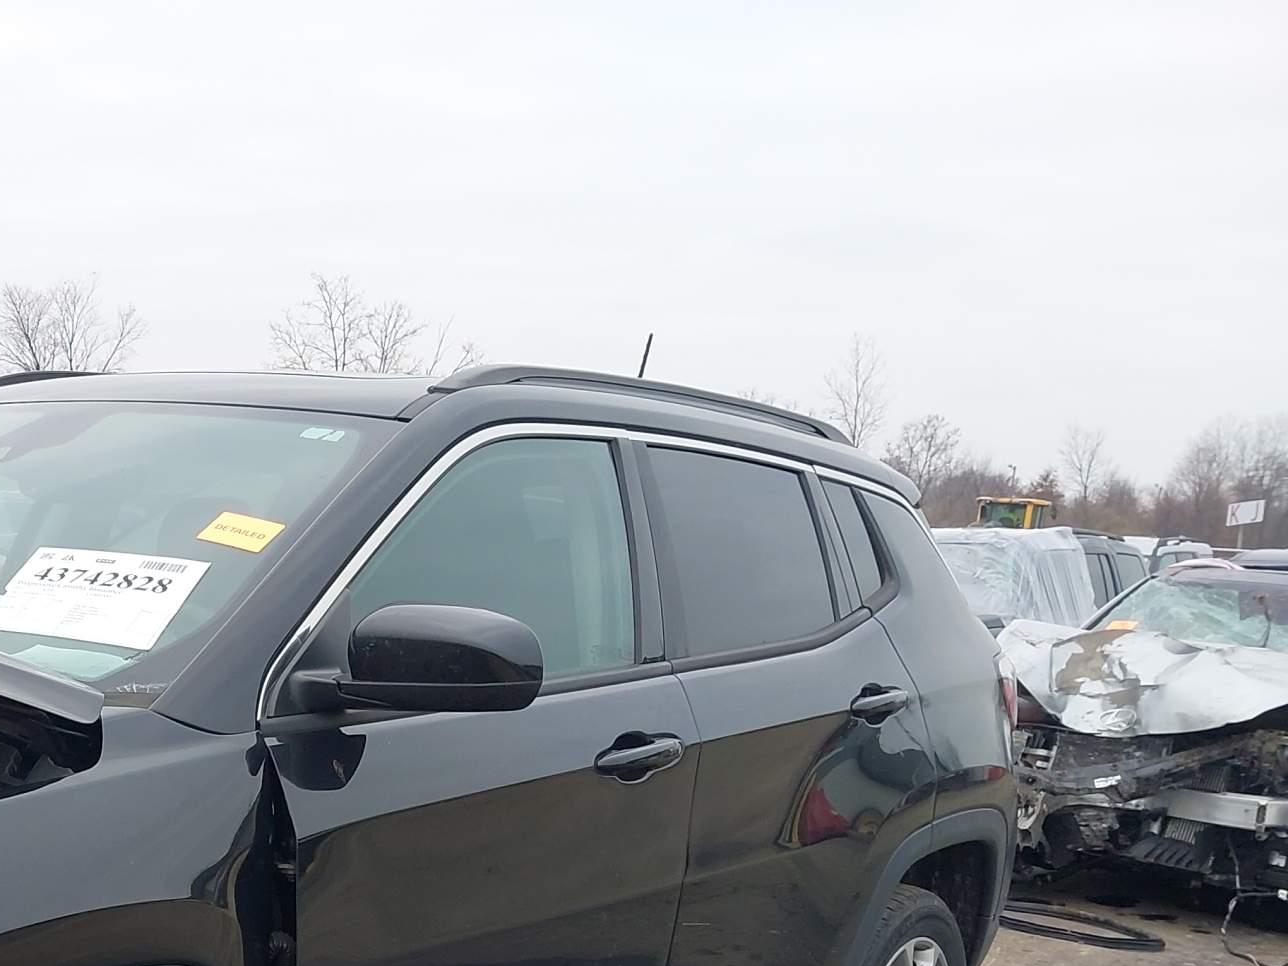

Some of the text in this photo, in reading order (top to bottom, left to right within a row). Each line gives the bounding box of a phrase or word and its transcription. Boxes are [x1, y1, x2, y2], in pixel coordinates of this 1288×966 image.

[1230, 504, 1240, 524] K
[215, 523, 266, 540] DETAILED
[34, 566, 173, 594] 43742828
